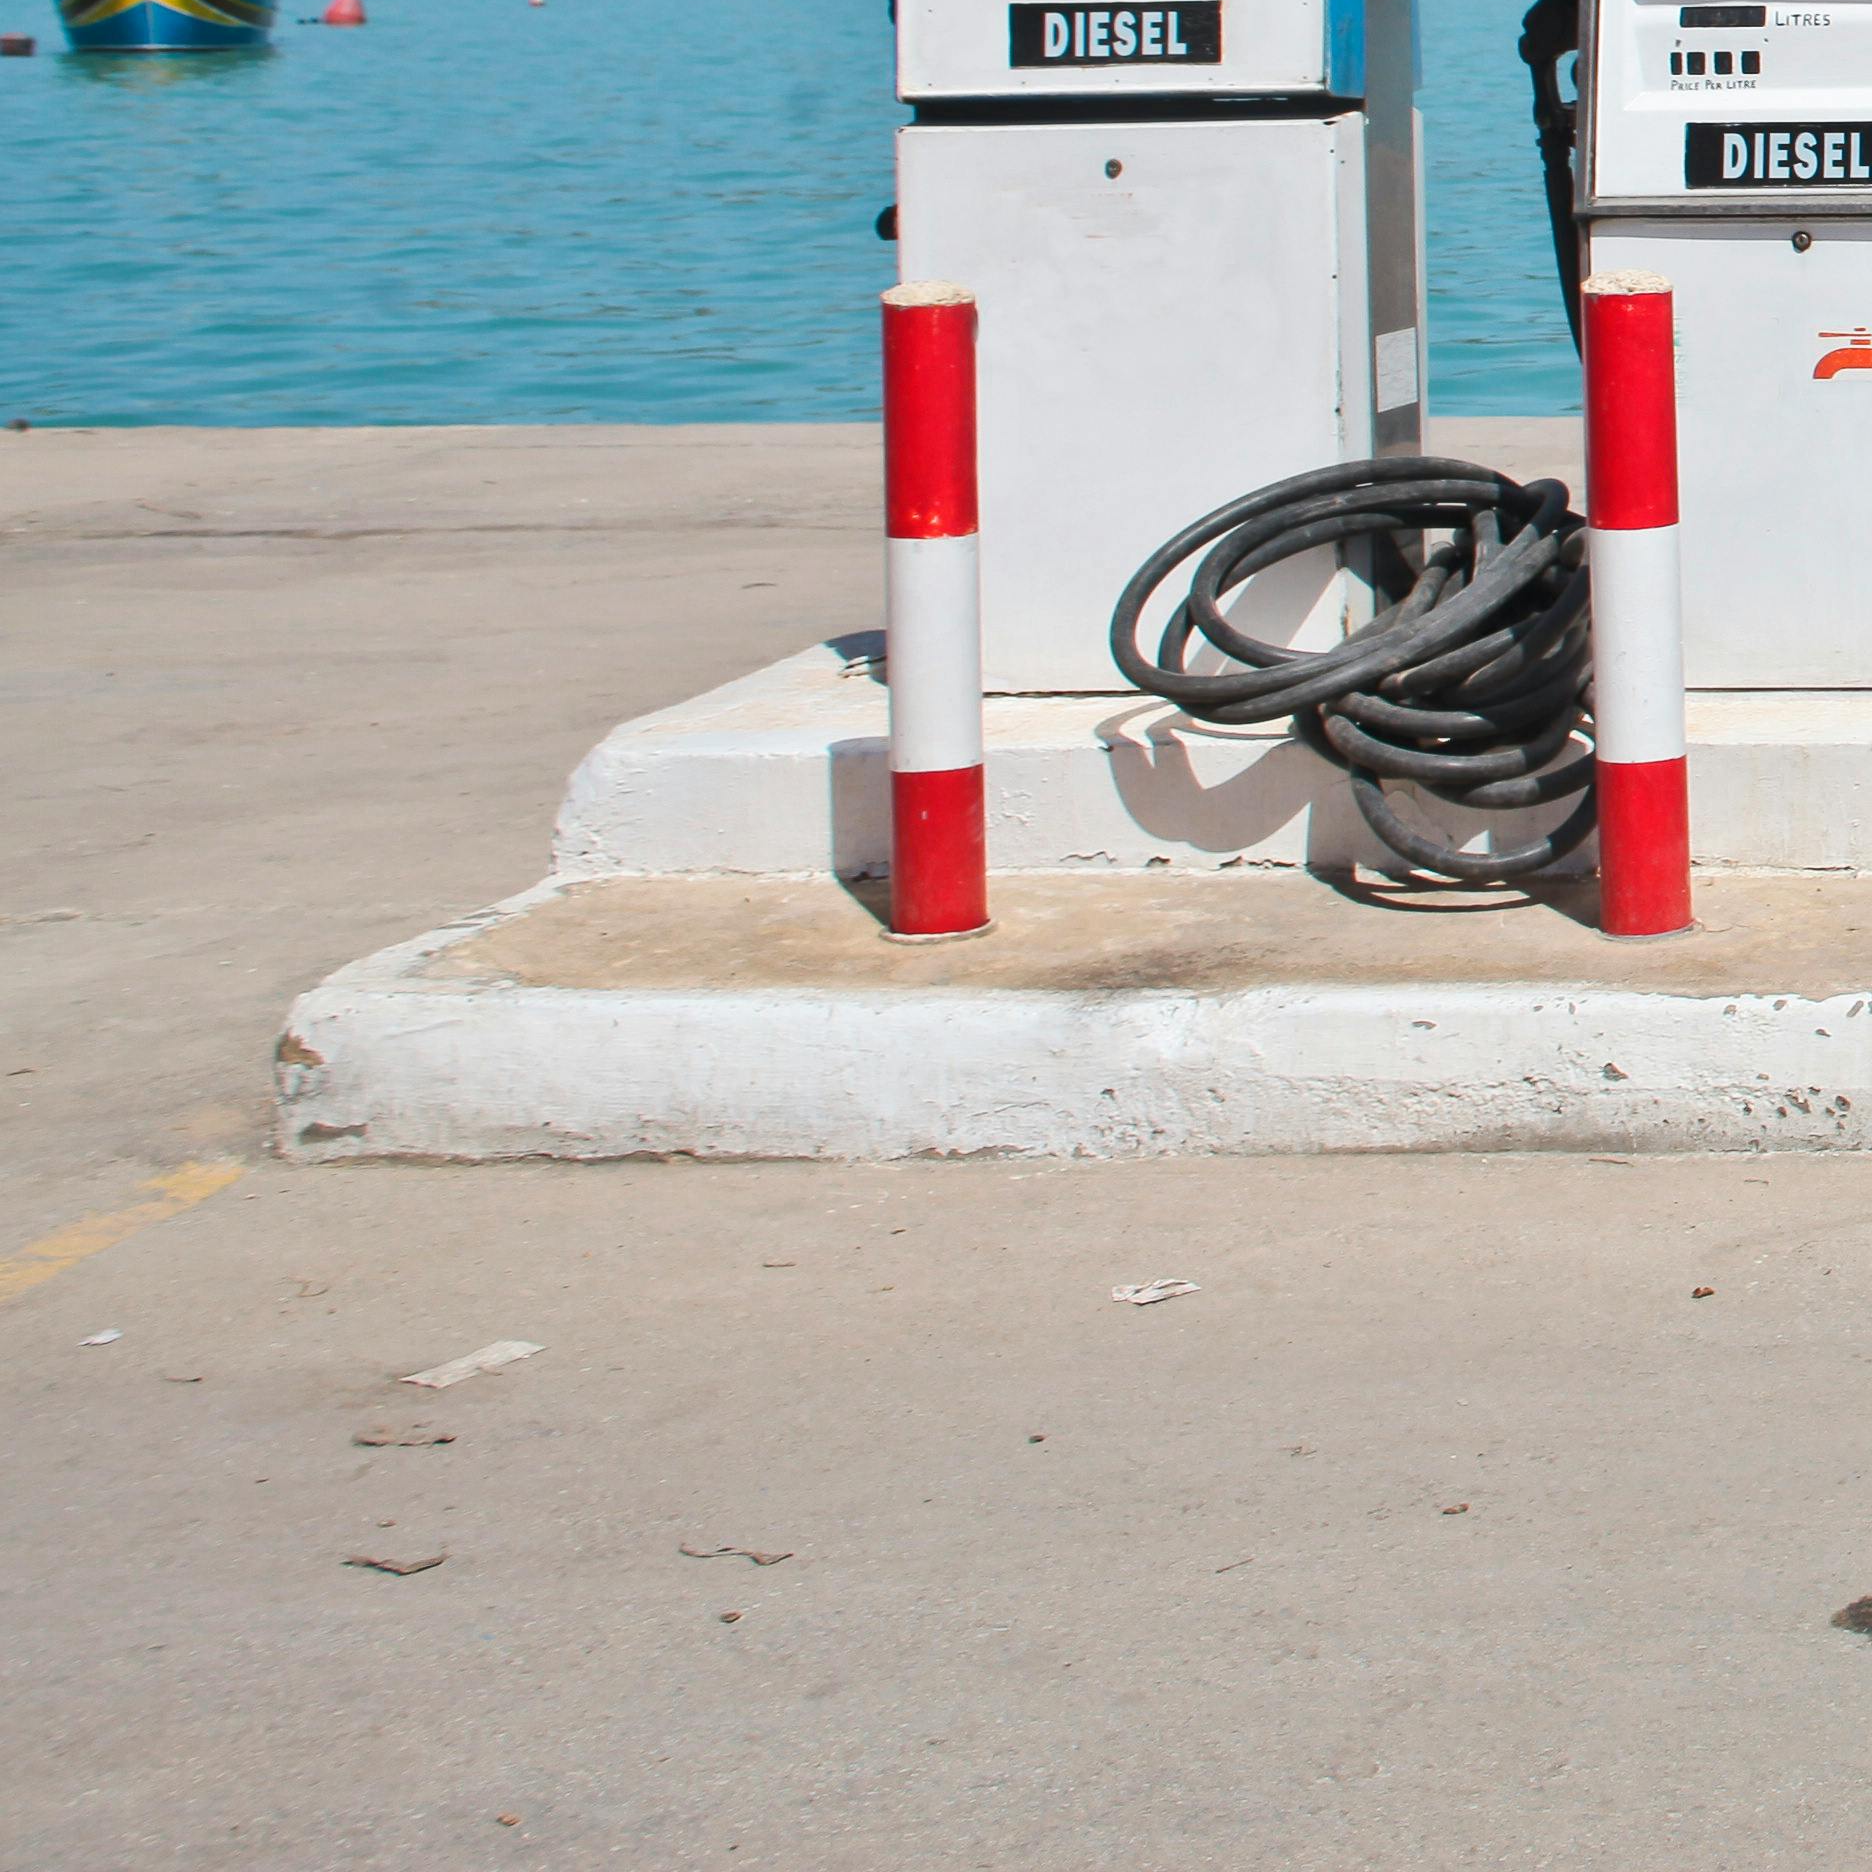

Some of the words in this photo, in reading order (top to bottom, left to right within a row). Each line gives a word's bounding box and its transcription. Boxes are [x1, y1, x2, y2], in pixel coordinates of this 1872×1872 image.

[1043, 10, 1188, 59] DIESEL
[1775, 11, 1831, 27] LITRES
[1721, 131, 1871, 180] DIESEL
